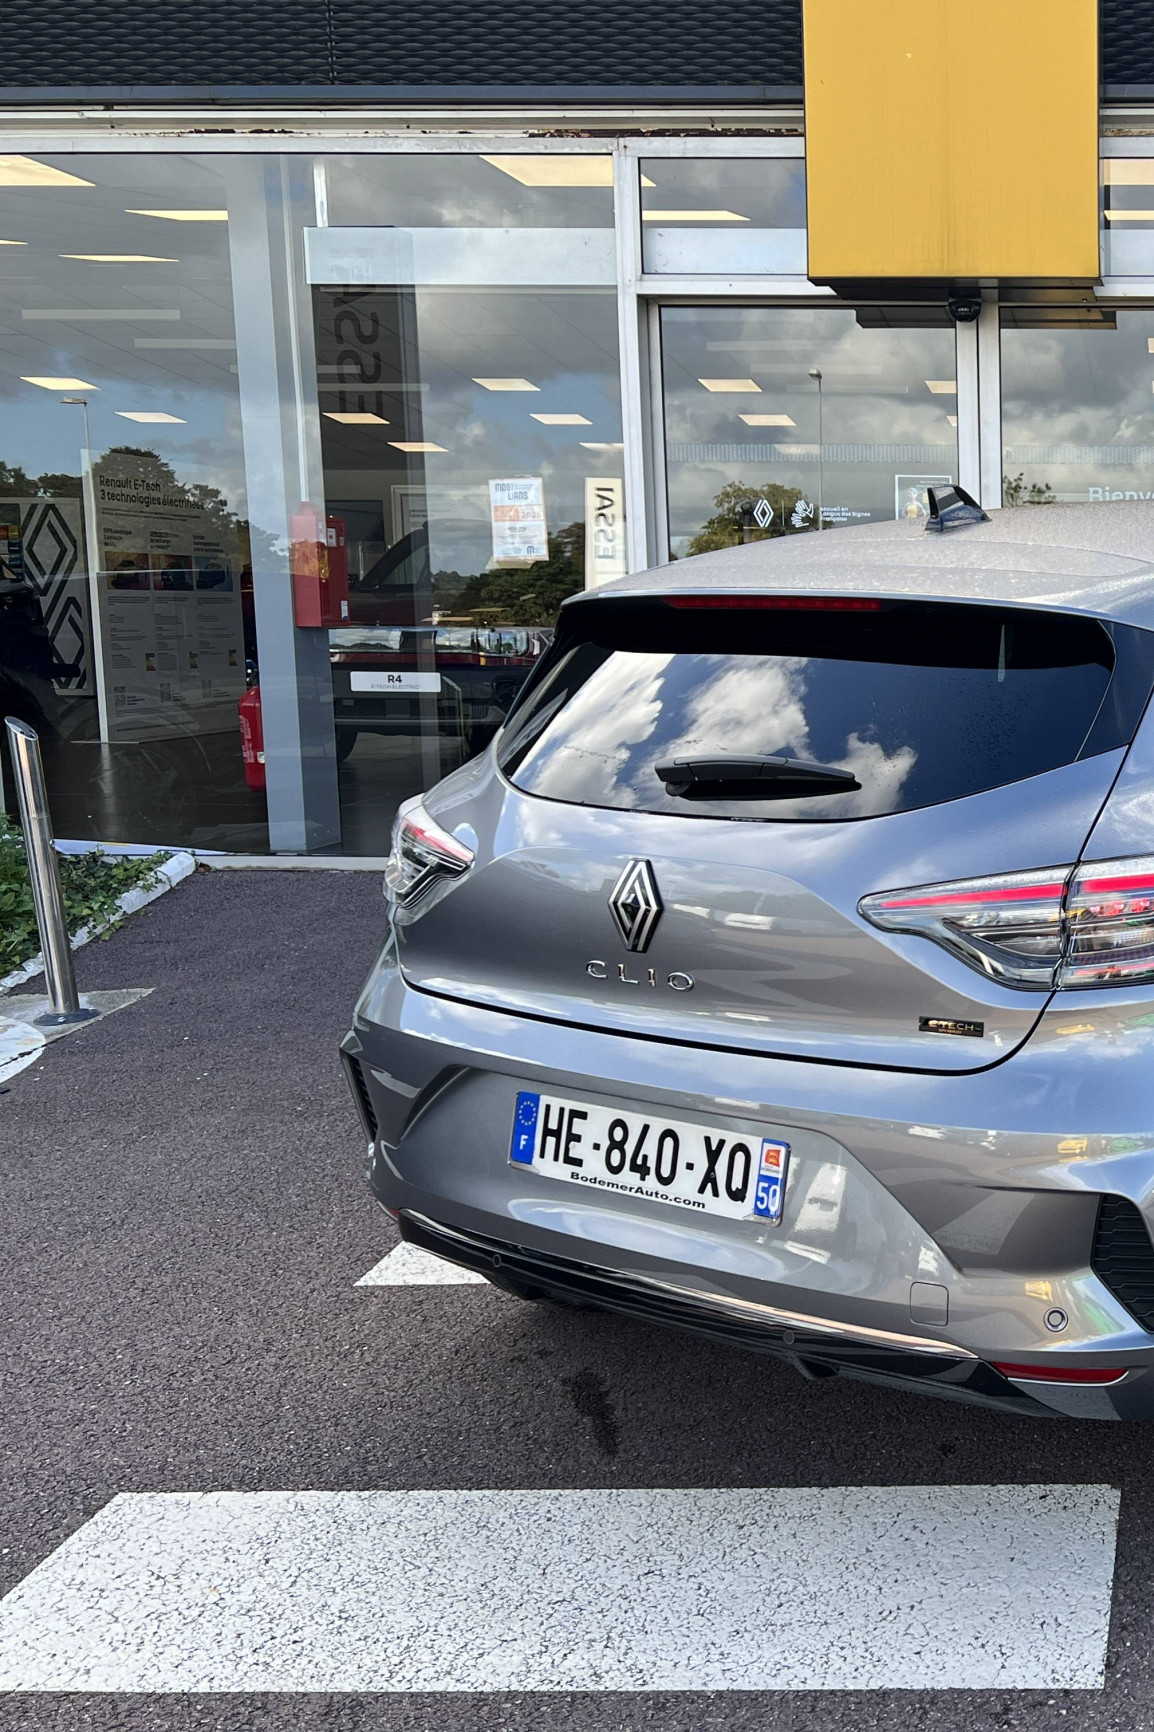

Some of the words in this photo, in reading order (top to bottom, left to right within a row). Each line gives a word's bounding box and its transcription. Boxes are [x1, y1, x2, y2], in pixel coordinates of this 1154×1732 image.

[99, 474, 133, 490] Renault
[133, 479, 161, 493] E-Tech
[100, 489, 106, 501] 3
[106, 490, 162, 508] technologies
[387, 674, 402, 684] R4
[586, 960, 695, 992] CLIO
[519, 1135, 529, 1150] F
[538, 1103, 751, 1203] HE-840-XQ
[570, 1171, 706, 1210] BodemerAuto.com
[756, 1181, 780, 1212] 50
